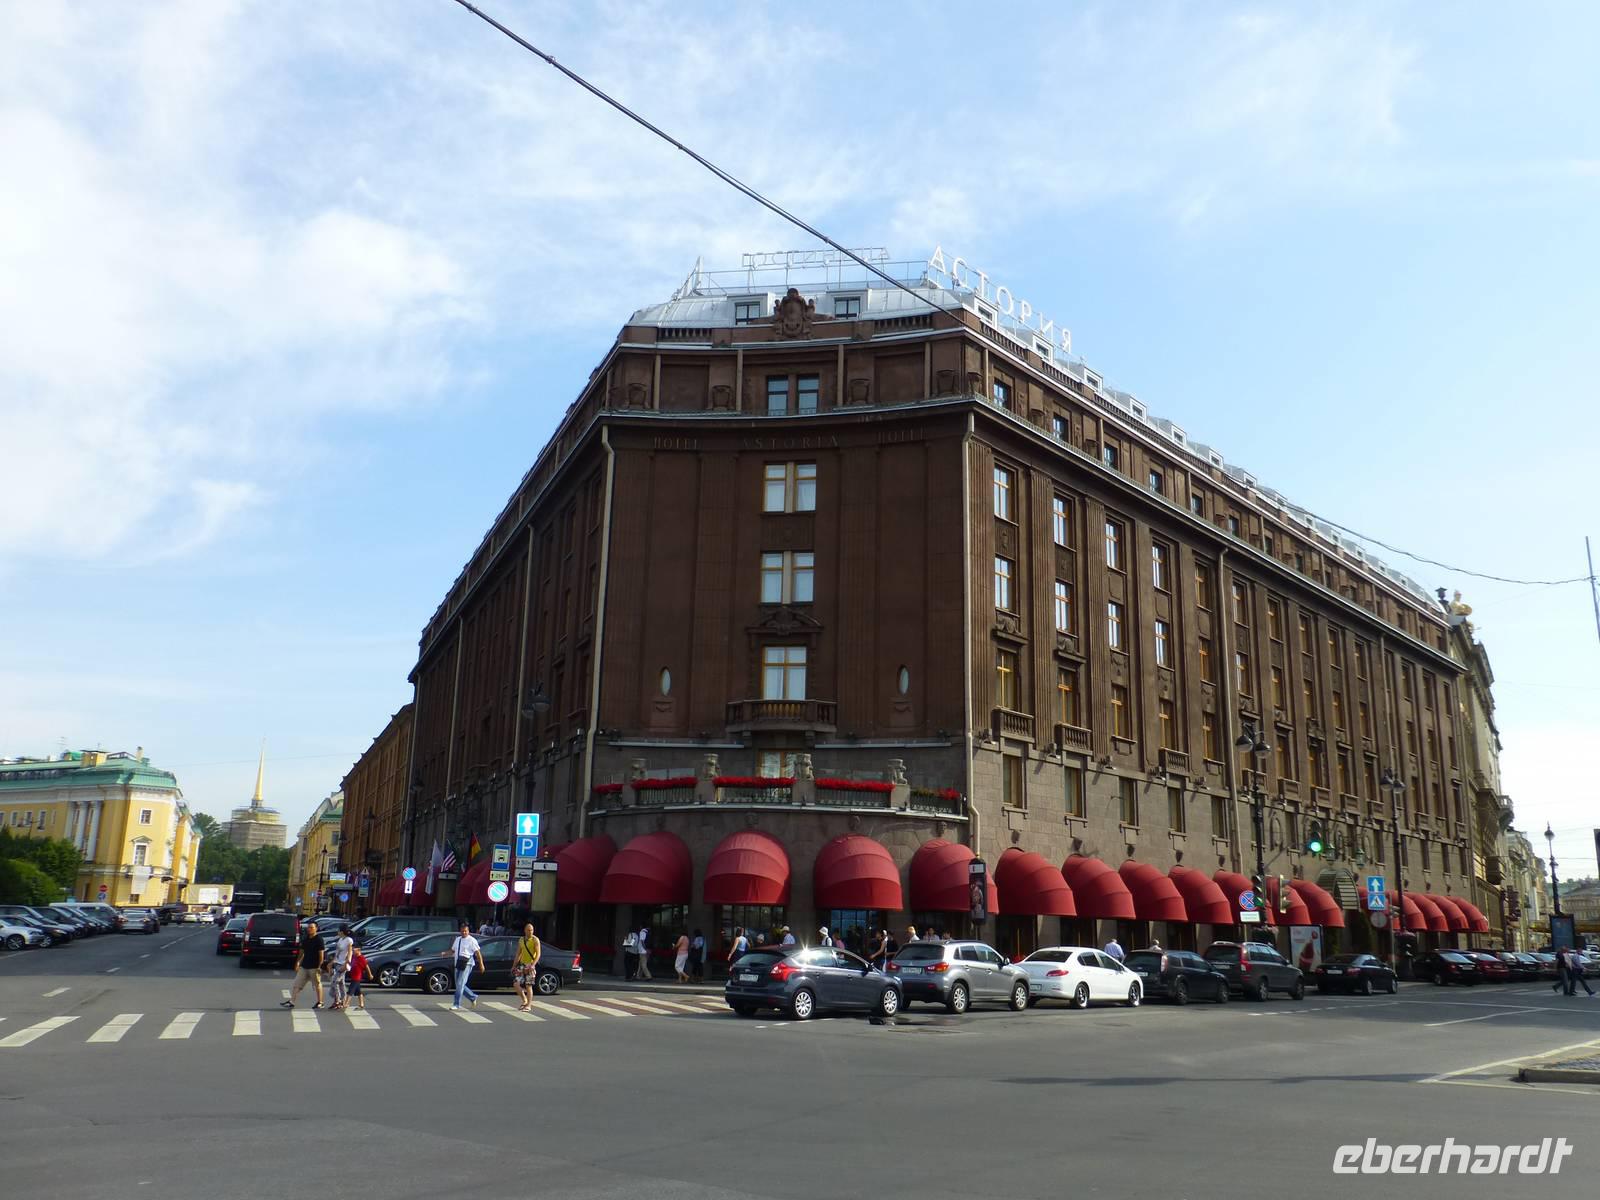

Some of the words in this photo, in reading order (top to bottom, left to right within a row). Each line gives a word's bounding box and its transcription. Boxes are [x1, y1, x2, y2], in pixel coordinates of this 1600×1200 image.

[928, 245, 1072, 353] АСТОРИЯ
[743, 436, 839, 449] ASTORIA
[521, 838, 534, 856] P
